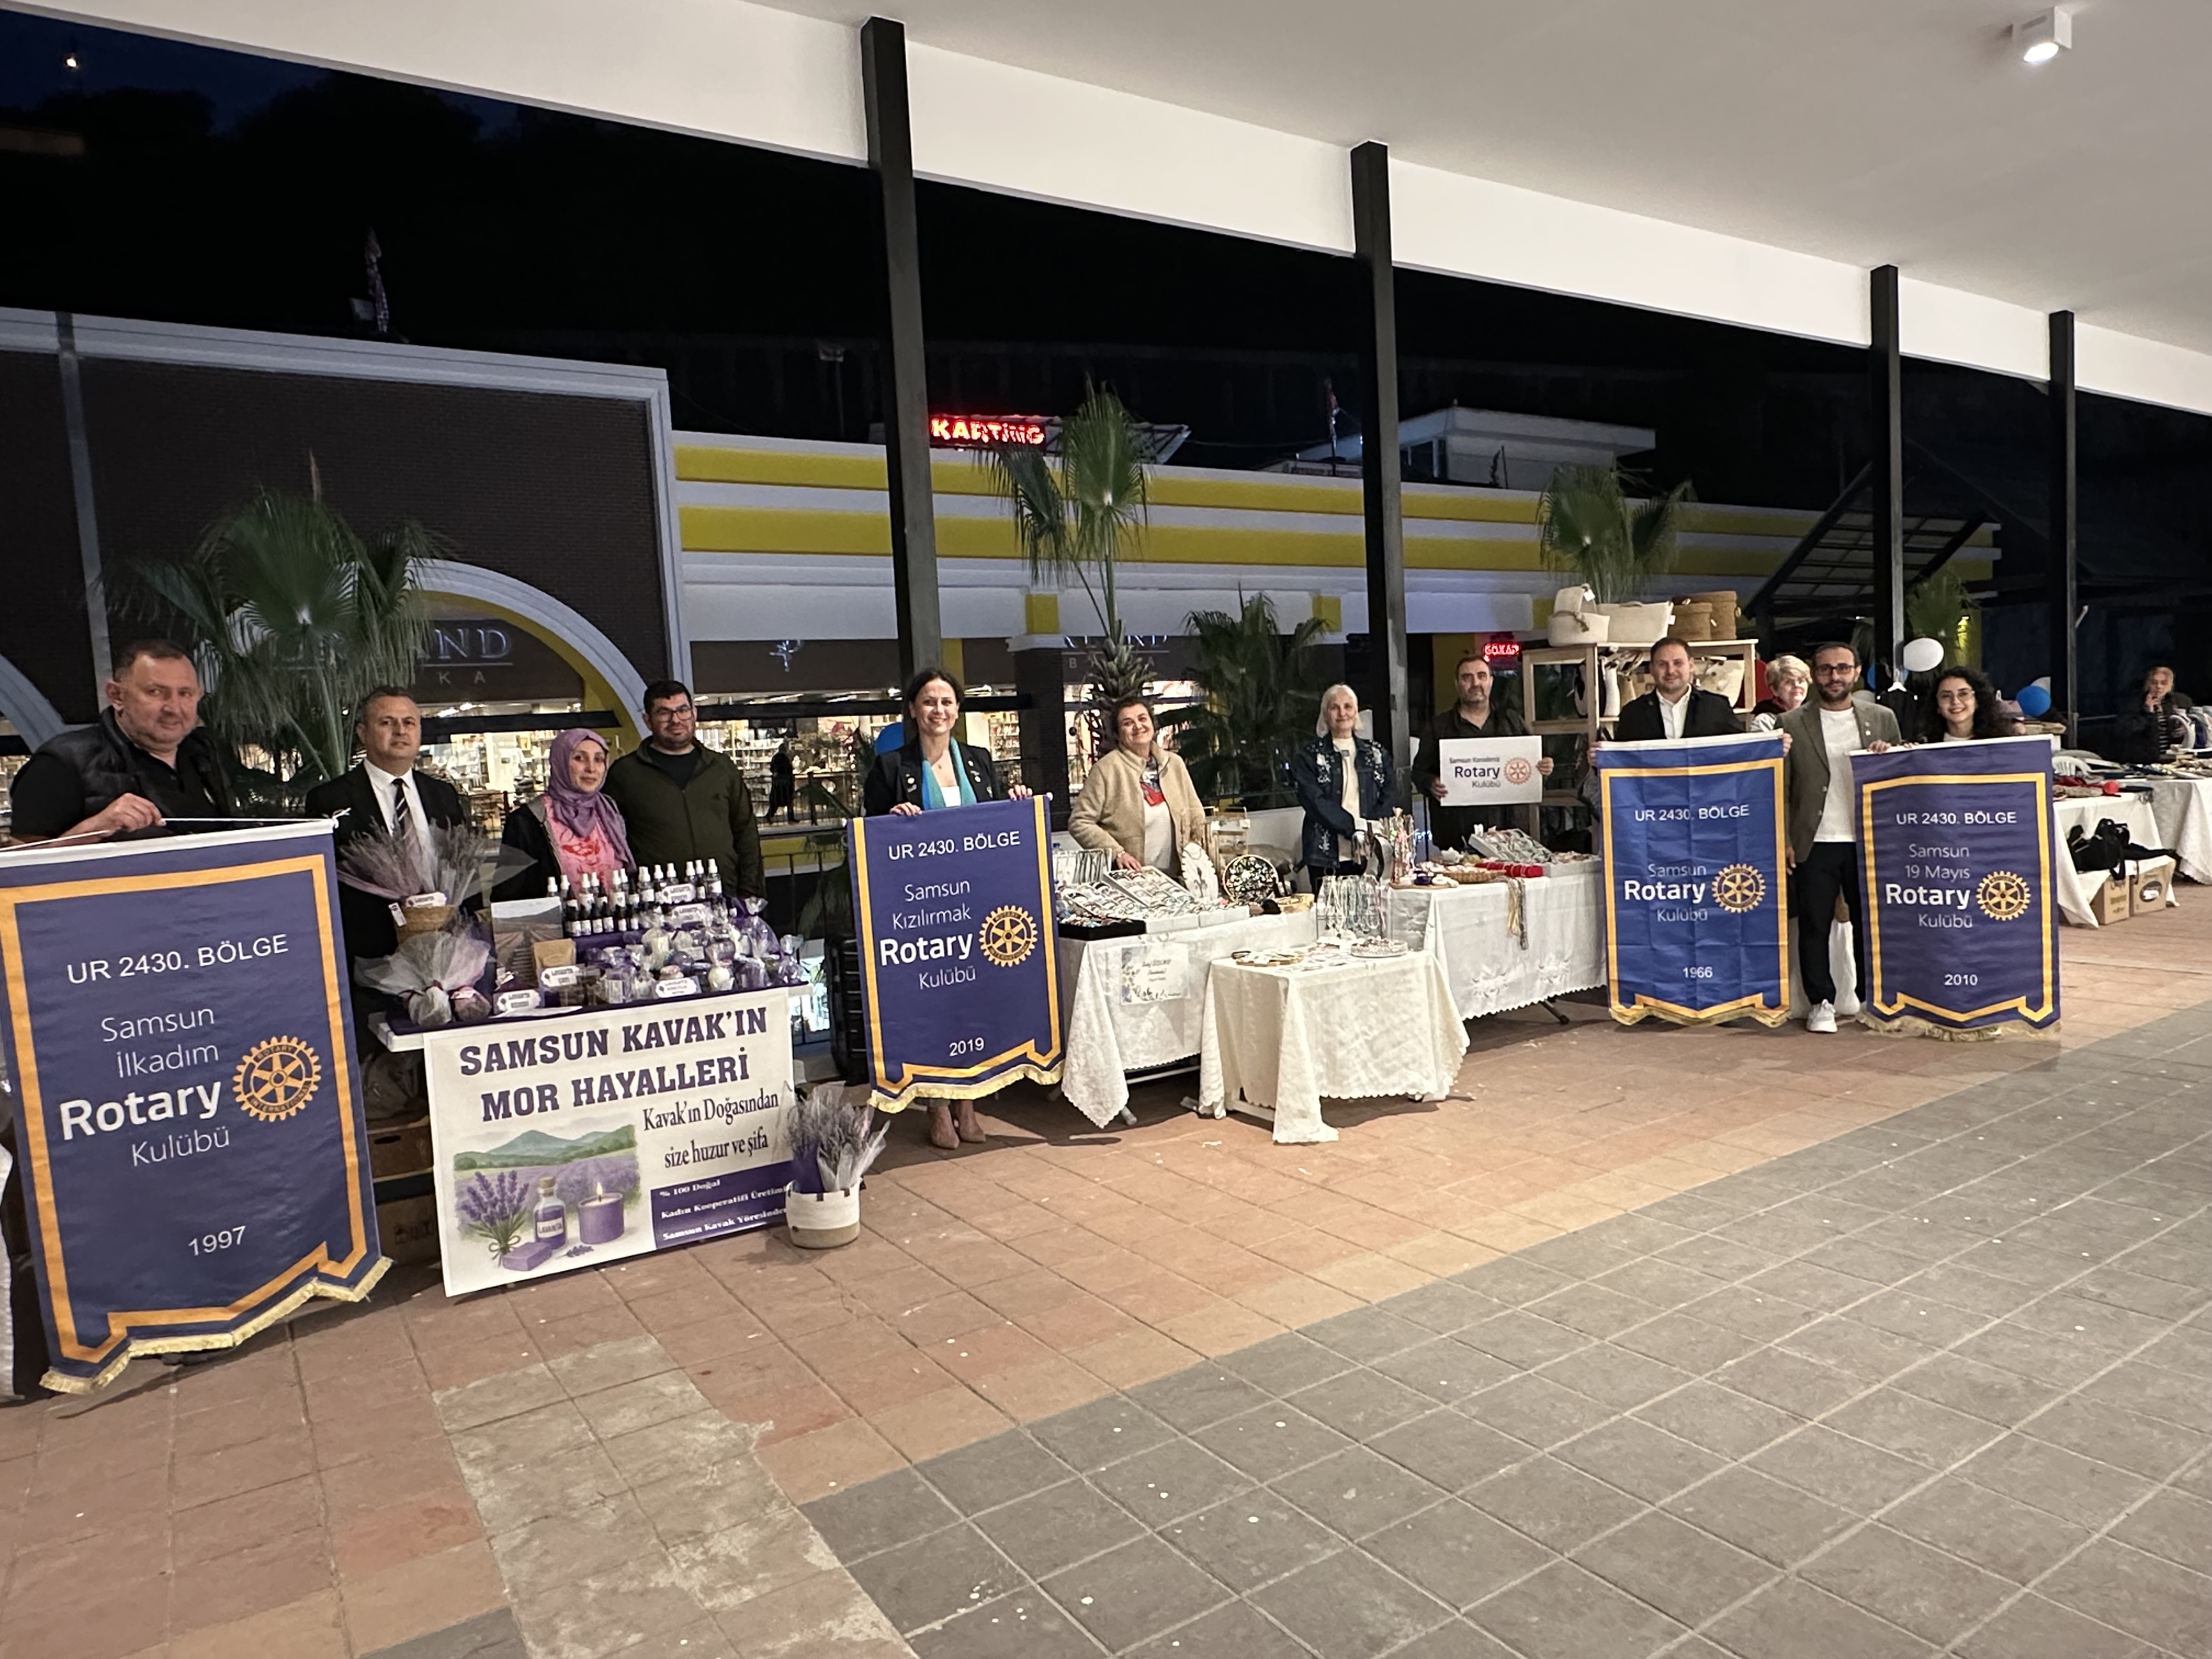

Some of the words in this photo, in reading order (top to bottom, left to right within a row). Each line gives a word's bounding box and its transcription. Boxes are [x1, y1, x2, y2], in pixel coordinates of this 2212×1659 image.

[1454, 766, 1500, 780] Rotary
[1635, 810, 1656, 822] UR
[1659, 809, 1695, 821] 2430.
[1699, 804, 1750, 820] BÖLGE
[1896, 813, 1918, 825] UR
[1922, 812, 1960, 824] 2430.
[1964, 810, 2017, 824] BÖLGE
[889, 844, 914, 860] UR
[918, 839, 960, 857] 2430.
[963, 831, 1020, 851] BÖLGE
[1908, 844, 1970, 858] Samsun
[1647, 864, 1707, 878] Samsun
[1905, 865, 1920, 879] 19
[1925, 865, 1971, 882] Mayıs
[904, 880, 970, 902] Samsun
[1624, 880, 1706, 904] Rotary
[1885, 883, 1971, 911] Rotary
[892, 905, 972, 930] Kızılırmak
[1656, 907, 1709, 922] Kulübü
[1918, 912, 1973, 929] Kulübü
[66, 960, 111, 984] UR
[118, 951, 190, 977] 2430.
[197, 933, 289, 967] BÖLGE
[879, 933, 973, 967] Rotary
[918, 964, 976, 990] Kulübü
[1683, 966, 1713, 979] 1966
[1944, 973, 1979, 986] 2010
[101, 1008, 216, 1043] Samsun
[460, 1028, 609, 1076] SAMSUN
[622, 1007, 768, 1053] KAVAK'IN
[949, 1036, 985, 1057] 2019
[116, 1043, 219, 1079] İlkadım
[481, 1084, 560, 1122] MOR
[572, 1046, 750, 1107] HAYALLERİ
[59, 1081, 222, 1140] Rotary
[642, 1101, 702, 1131] Kavak'ın
[703, 1088, 779, 1125] Doğasından
[131, 1125, 230, 1167] Kulübü
[664, 1146, 690, 1168] size
[691, 1139, 730, 1163] huzur
[731, 1138, 746, 1154] ve
[748, 1126, 769, 1157] şifa
[674, 1187, 690, 1195] 100
[692, 1179, 721, 1192] Doğal
[661, 1207, 692, 1219] Kadın
[188, 1225, 247, 1256] 1997
[663, 1226, 703, 1241] Samsun
[704, 1217, 736, 1232] Kavak
